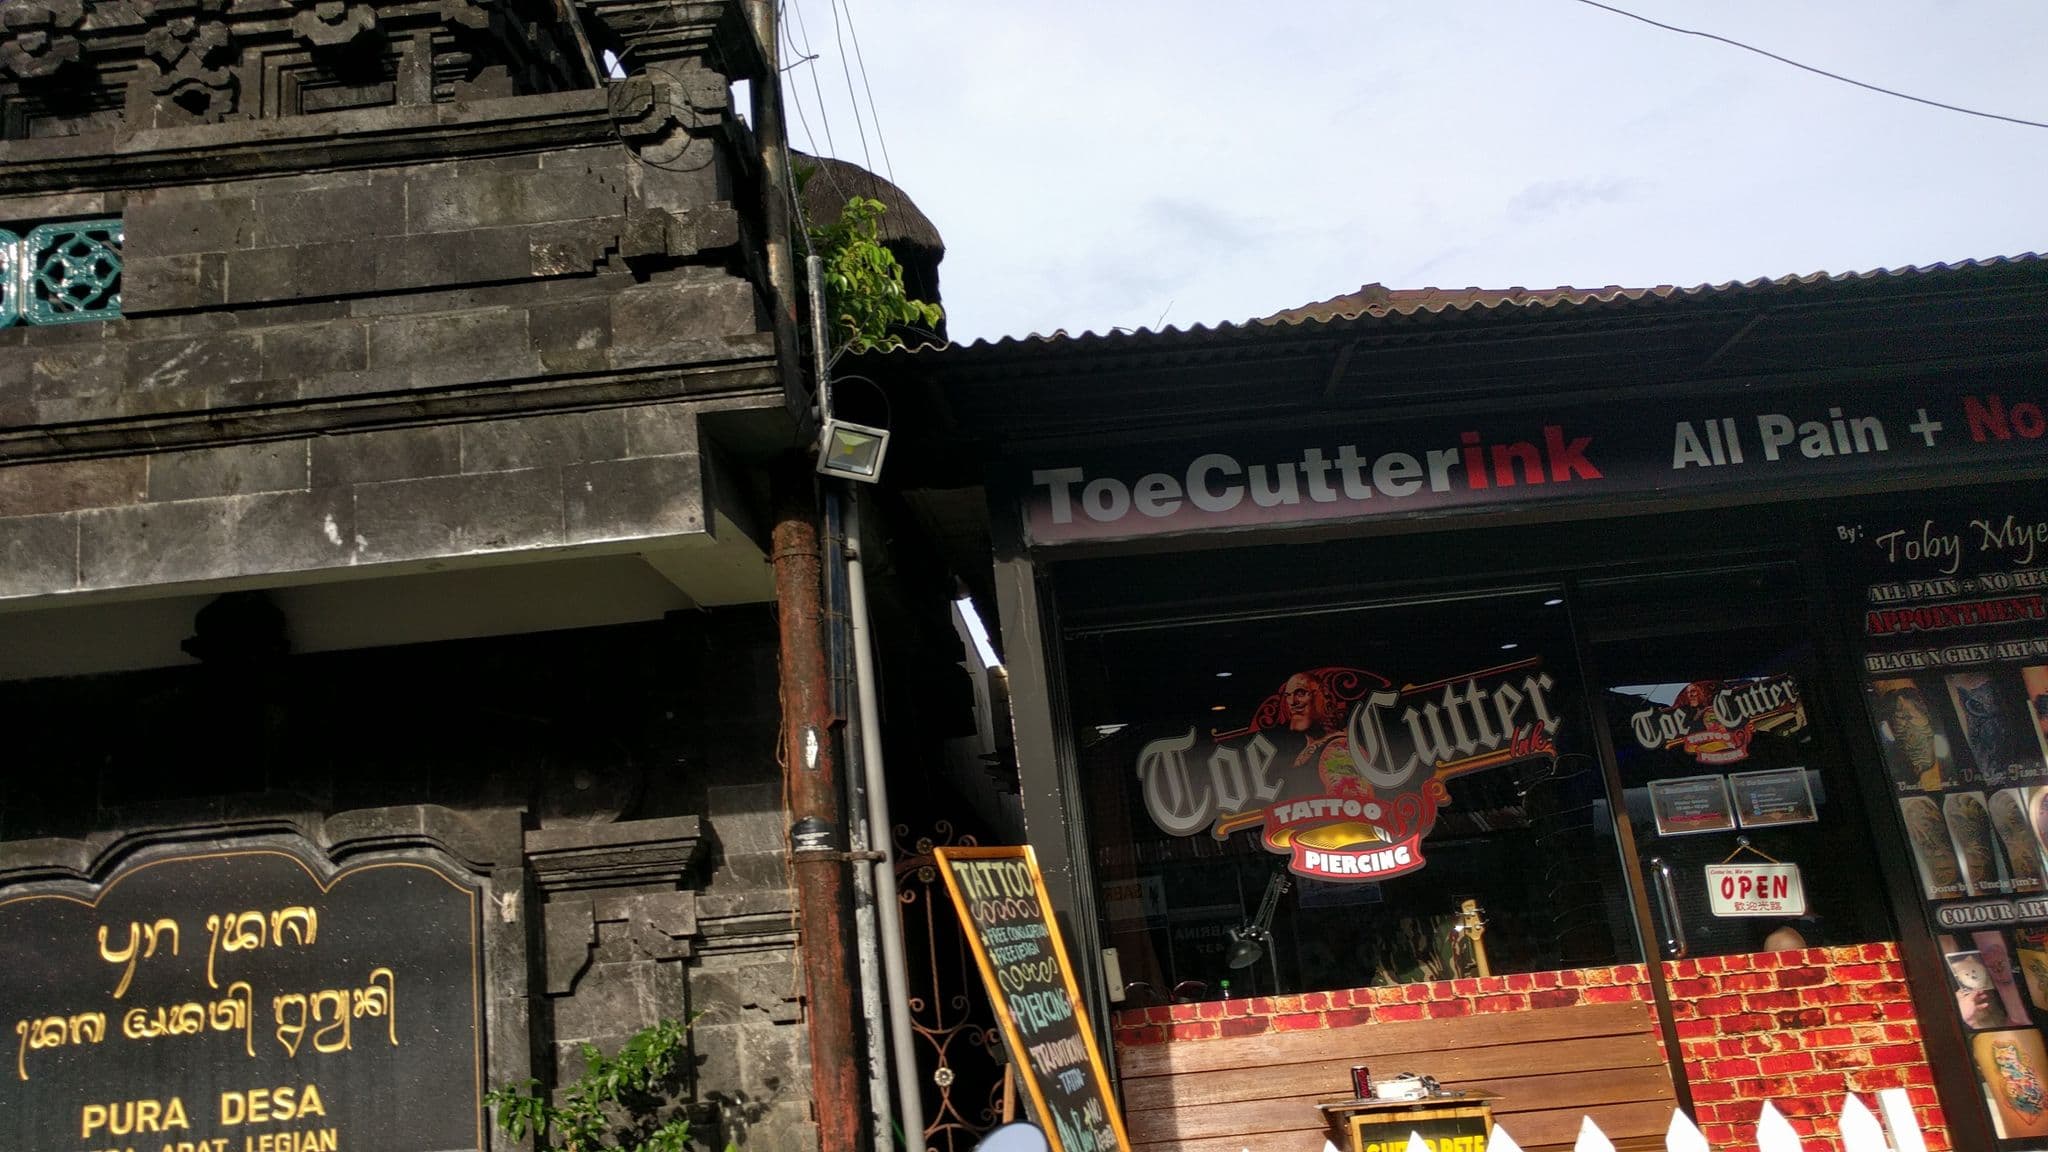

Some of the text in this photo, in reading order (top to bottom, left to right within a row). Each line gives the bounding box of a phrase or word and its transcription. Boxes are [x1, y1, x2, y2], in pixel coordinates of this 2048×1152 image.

[1673, 417, 1744, 470] All
[1757, 407, 1888, 462] Pain
[1963, 393, 2046, 444] No
[1033, 425, 1601, 525] ToeCutterink
[1837, 525, 1864, 544] By:
[1876, 520, 1960, 574] Toby
[1870, 584, 1907, 602] ALL
[1911, 579, 1958, 599] PAIN
[1980, 573, 2008, 591] NO
[1867, 595, 2045, 635] APPOINTMENT
[1866, 651, 1926, 672] BLACK
[1929, 650, 1944, 666] N
[1945, 645, 1989, 664] GREY
[1998, 641, 2030, 658] ART
[1347, 672, 1561, 790] Cutter
[1632, 678, 1798, 749] Toe Cutter
[1137, 726, 1284, 834] Toe
[1275, 798, 1381, 825] TATTOO
[953, 861, 1034, 899] TATTOO
[1305, 846, 1410, 874] PIERCING
[1721, 875, 1788, 900] OPEN
[1941, 903, 2014, 925] COLOUR
[1012, 989, 1072, 1034] PIERCING
[82, 1084, 326, 1139] PURA DESA
[246, 1128, 338, 1152] LEGIAN
